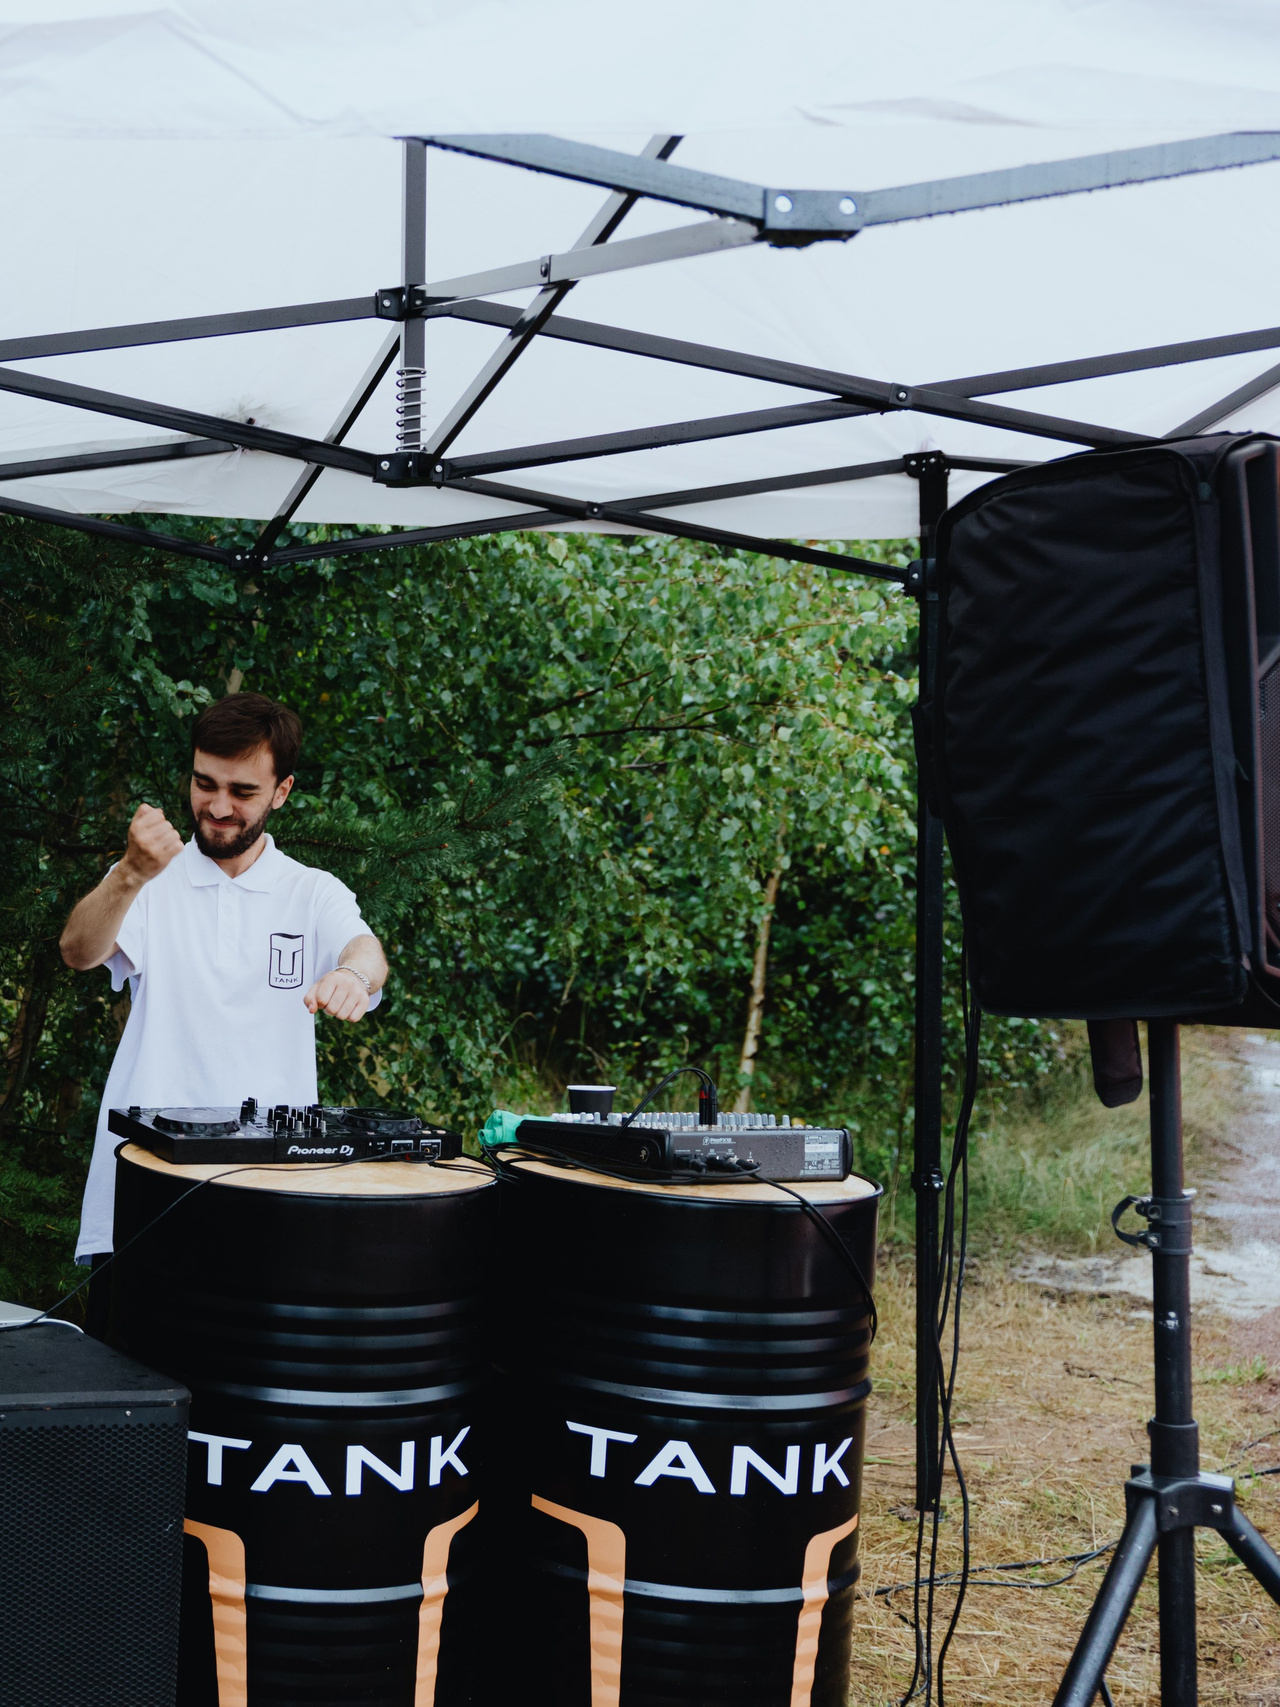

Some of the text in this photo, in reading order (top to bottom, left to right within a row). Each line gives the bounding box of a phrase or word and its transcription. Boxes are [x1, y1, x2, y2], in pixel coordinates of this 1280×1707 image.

[287, 1145, 337, 1155] Pioneer
[187, 1425, 470, 1495] TANK
[566, 1421, 853, 1495] TANK
